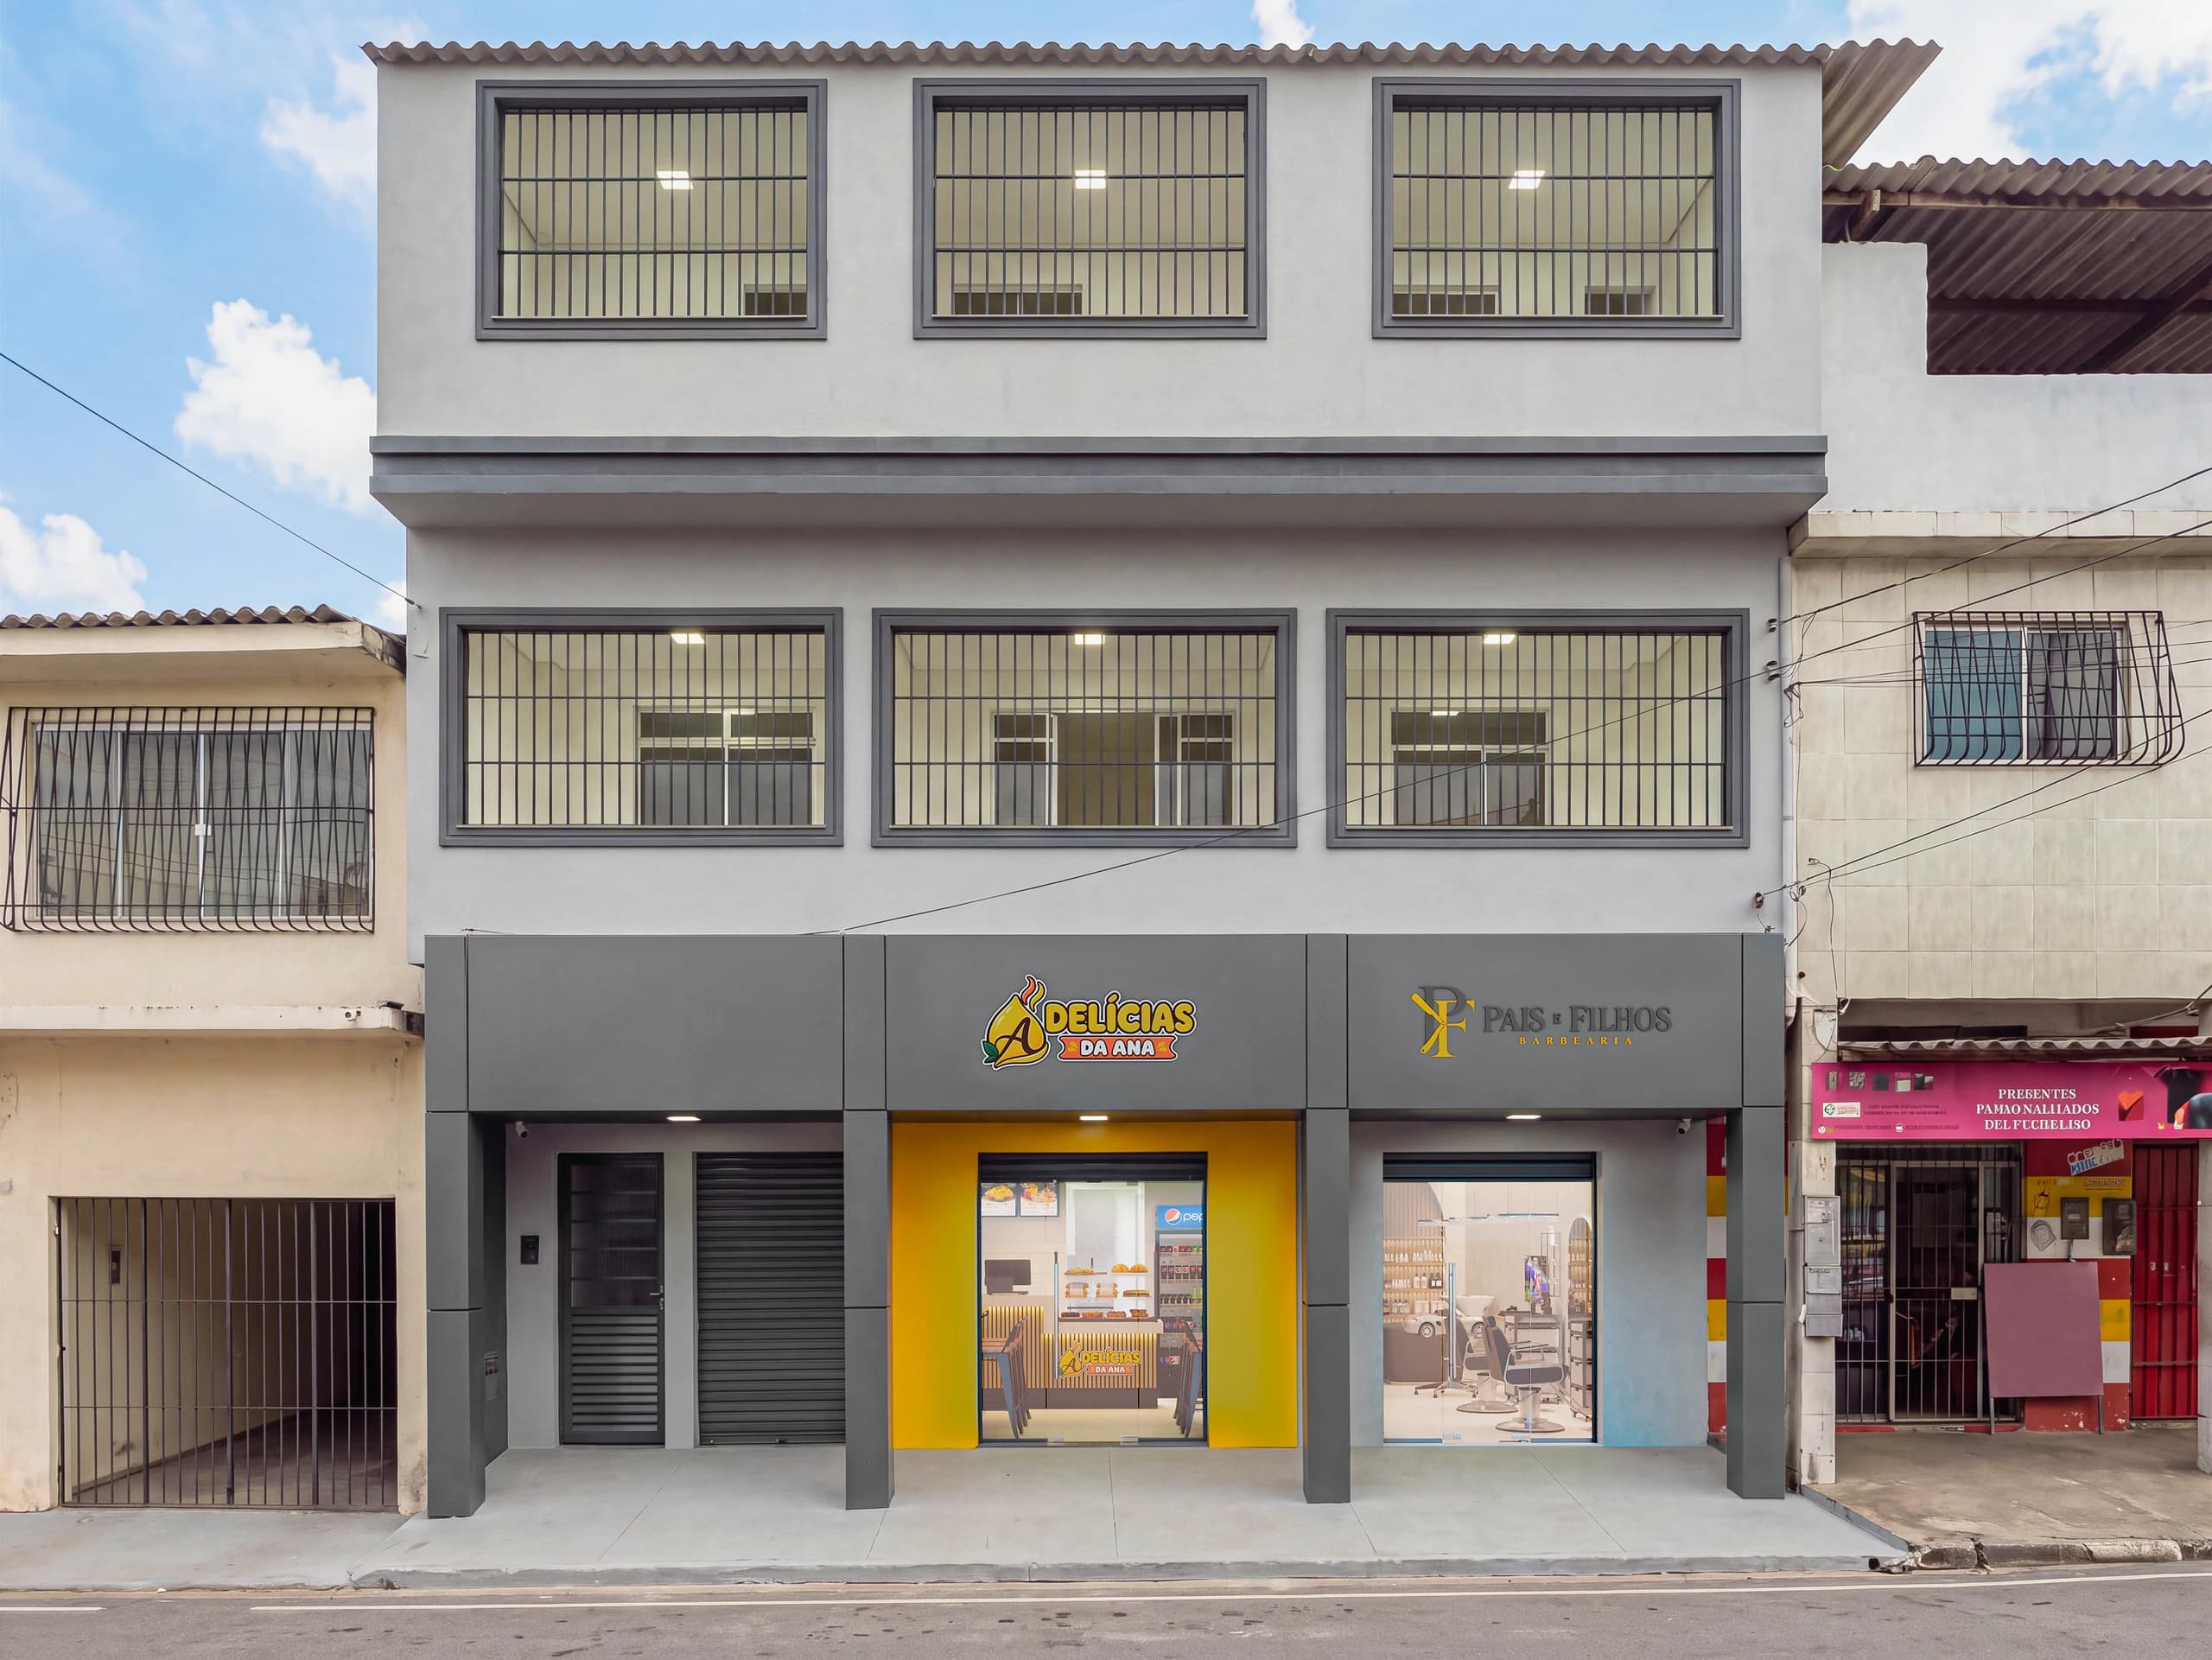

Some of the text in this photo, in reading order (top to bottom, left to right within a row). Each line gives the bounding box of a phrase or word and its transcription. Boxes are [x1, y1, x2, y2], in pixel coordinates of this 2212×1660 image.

[1045, 992, 1194, 1034] DELÍCIAS
[1482, 1005, 1673, 1033] PAIS E FILHOS
[1081, 1040, 1154, 1056] DA ANA
[1519, 1036, 1632, 1045] BARBEARIA
[1985, 1119, 2012, 1129] DEL
[1081, 1348, 1141, 1364] DELÍCIAS
